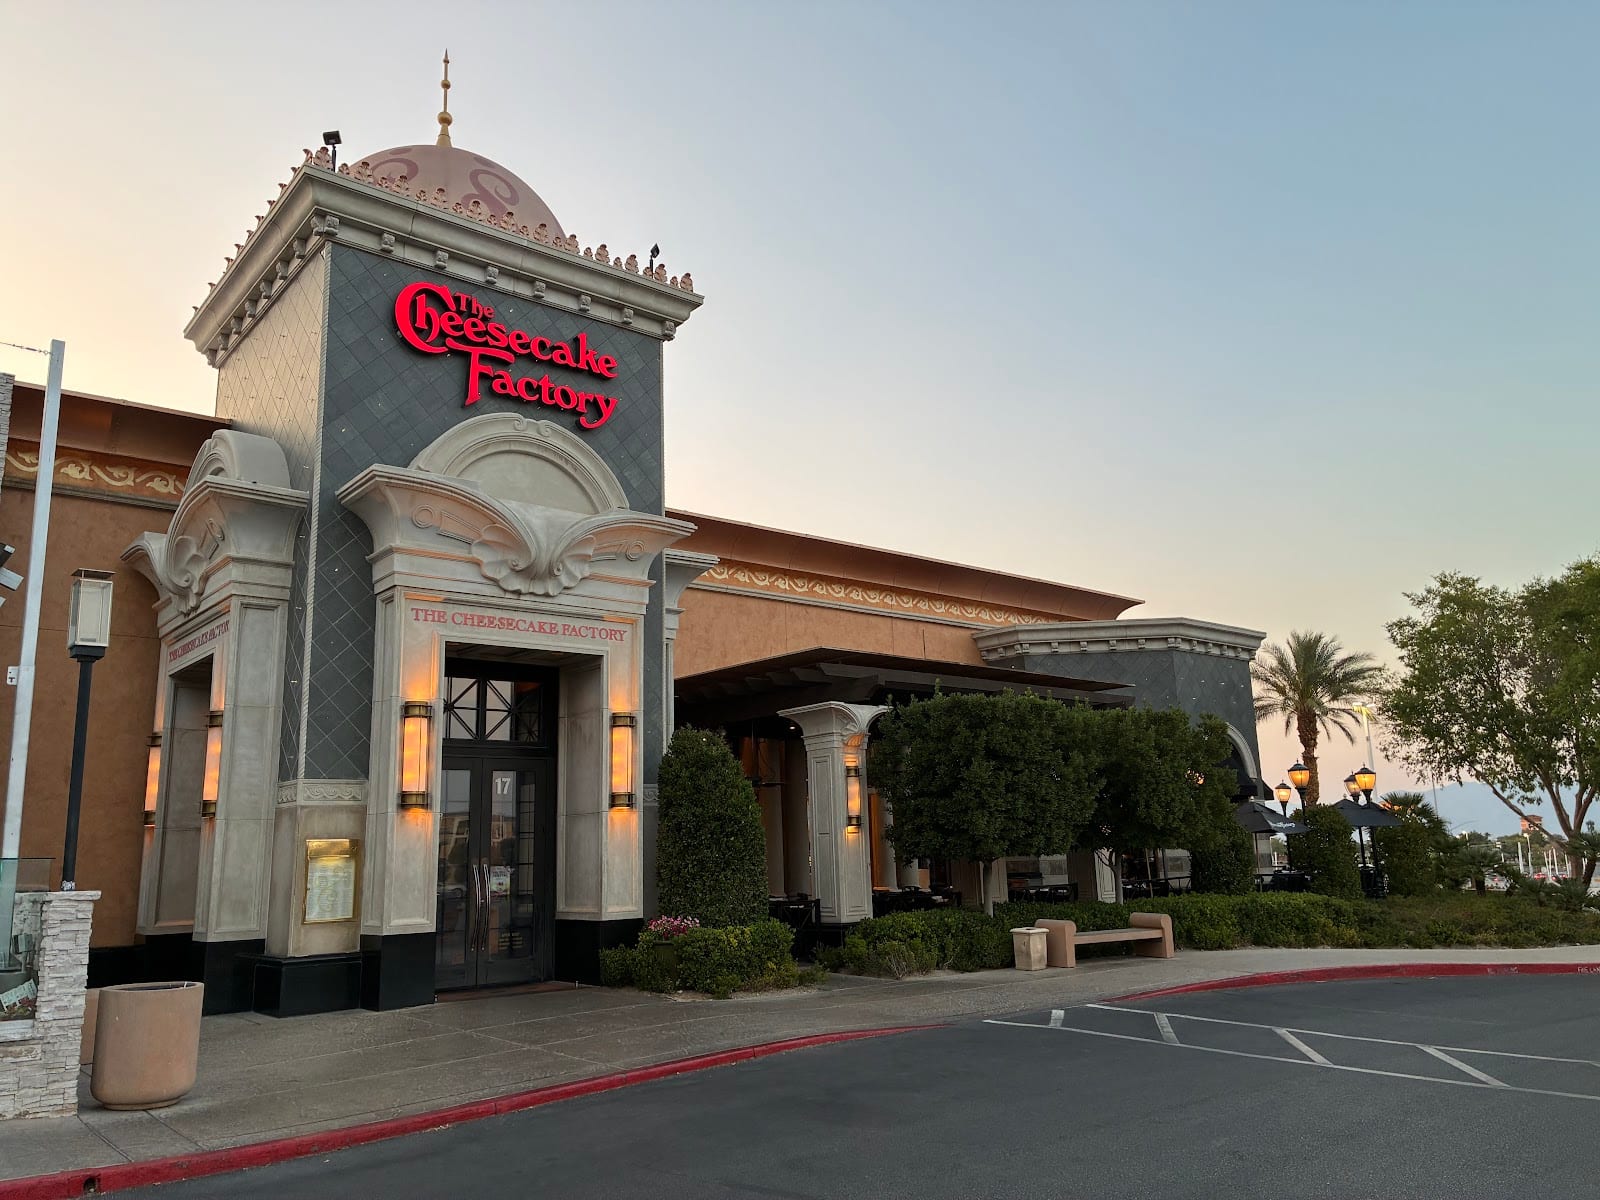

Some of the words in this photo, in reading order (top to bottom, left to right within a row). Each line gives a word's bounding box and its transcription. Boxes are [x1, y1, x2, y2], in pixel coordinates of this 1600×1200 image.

[454, 292, 495, 319] The
[395, 282, 618, 379] Cheesecake
[445, 337, 618, 429] Factory
[411, 607, 448, 624] THE
[451, 612, 559, 635] CHEESECAKE
[562, 623, 628, 642] FACTORY
[495, 777, 511, 794] 17
